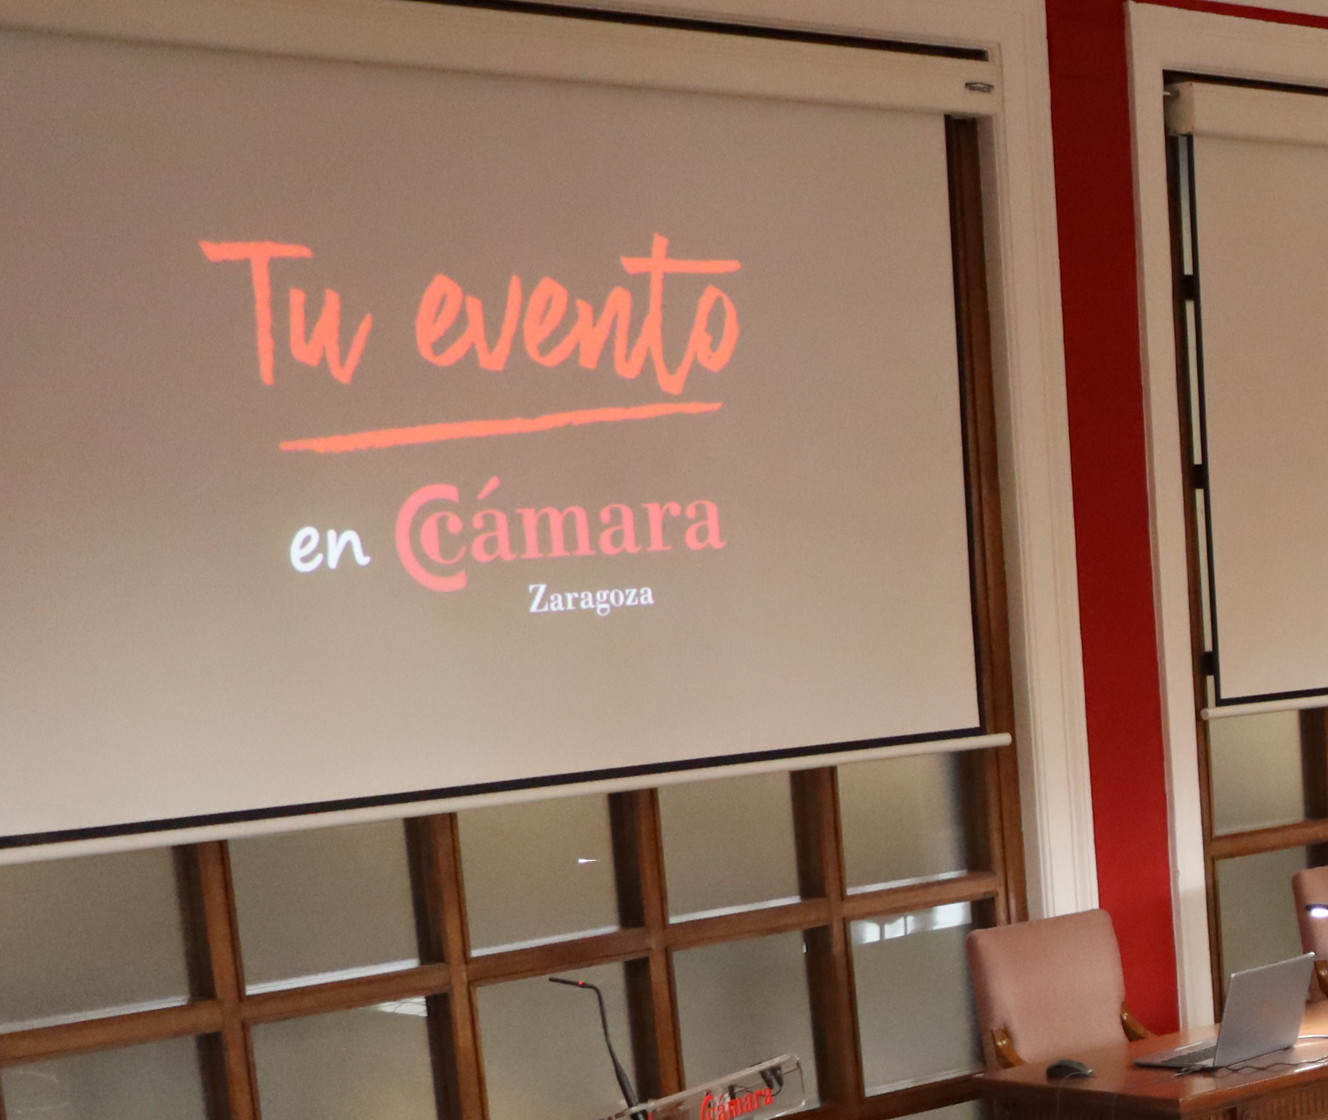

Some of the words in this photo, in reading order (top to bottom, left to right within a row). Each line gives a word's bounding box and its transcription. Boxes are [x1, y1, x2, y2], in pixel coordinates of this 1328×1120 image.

[199, 240, 373, 386] Tu
[415, 232, 743, 395] evento
[289, 525, 372, 573] en
[528, 583, 655, 617] Zaragoza
